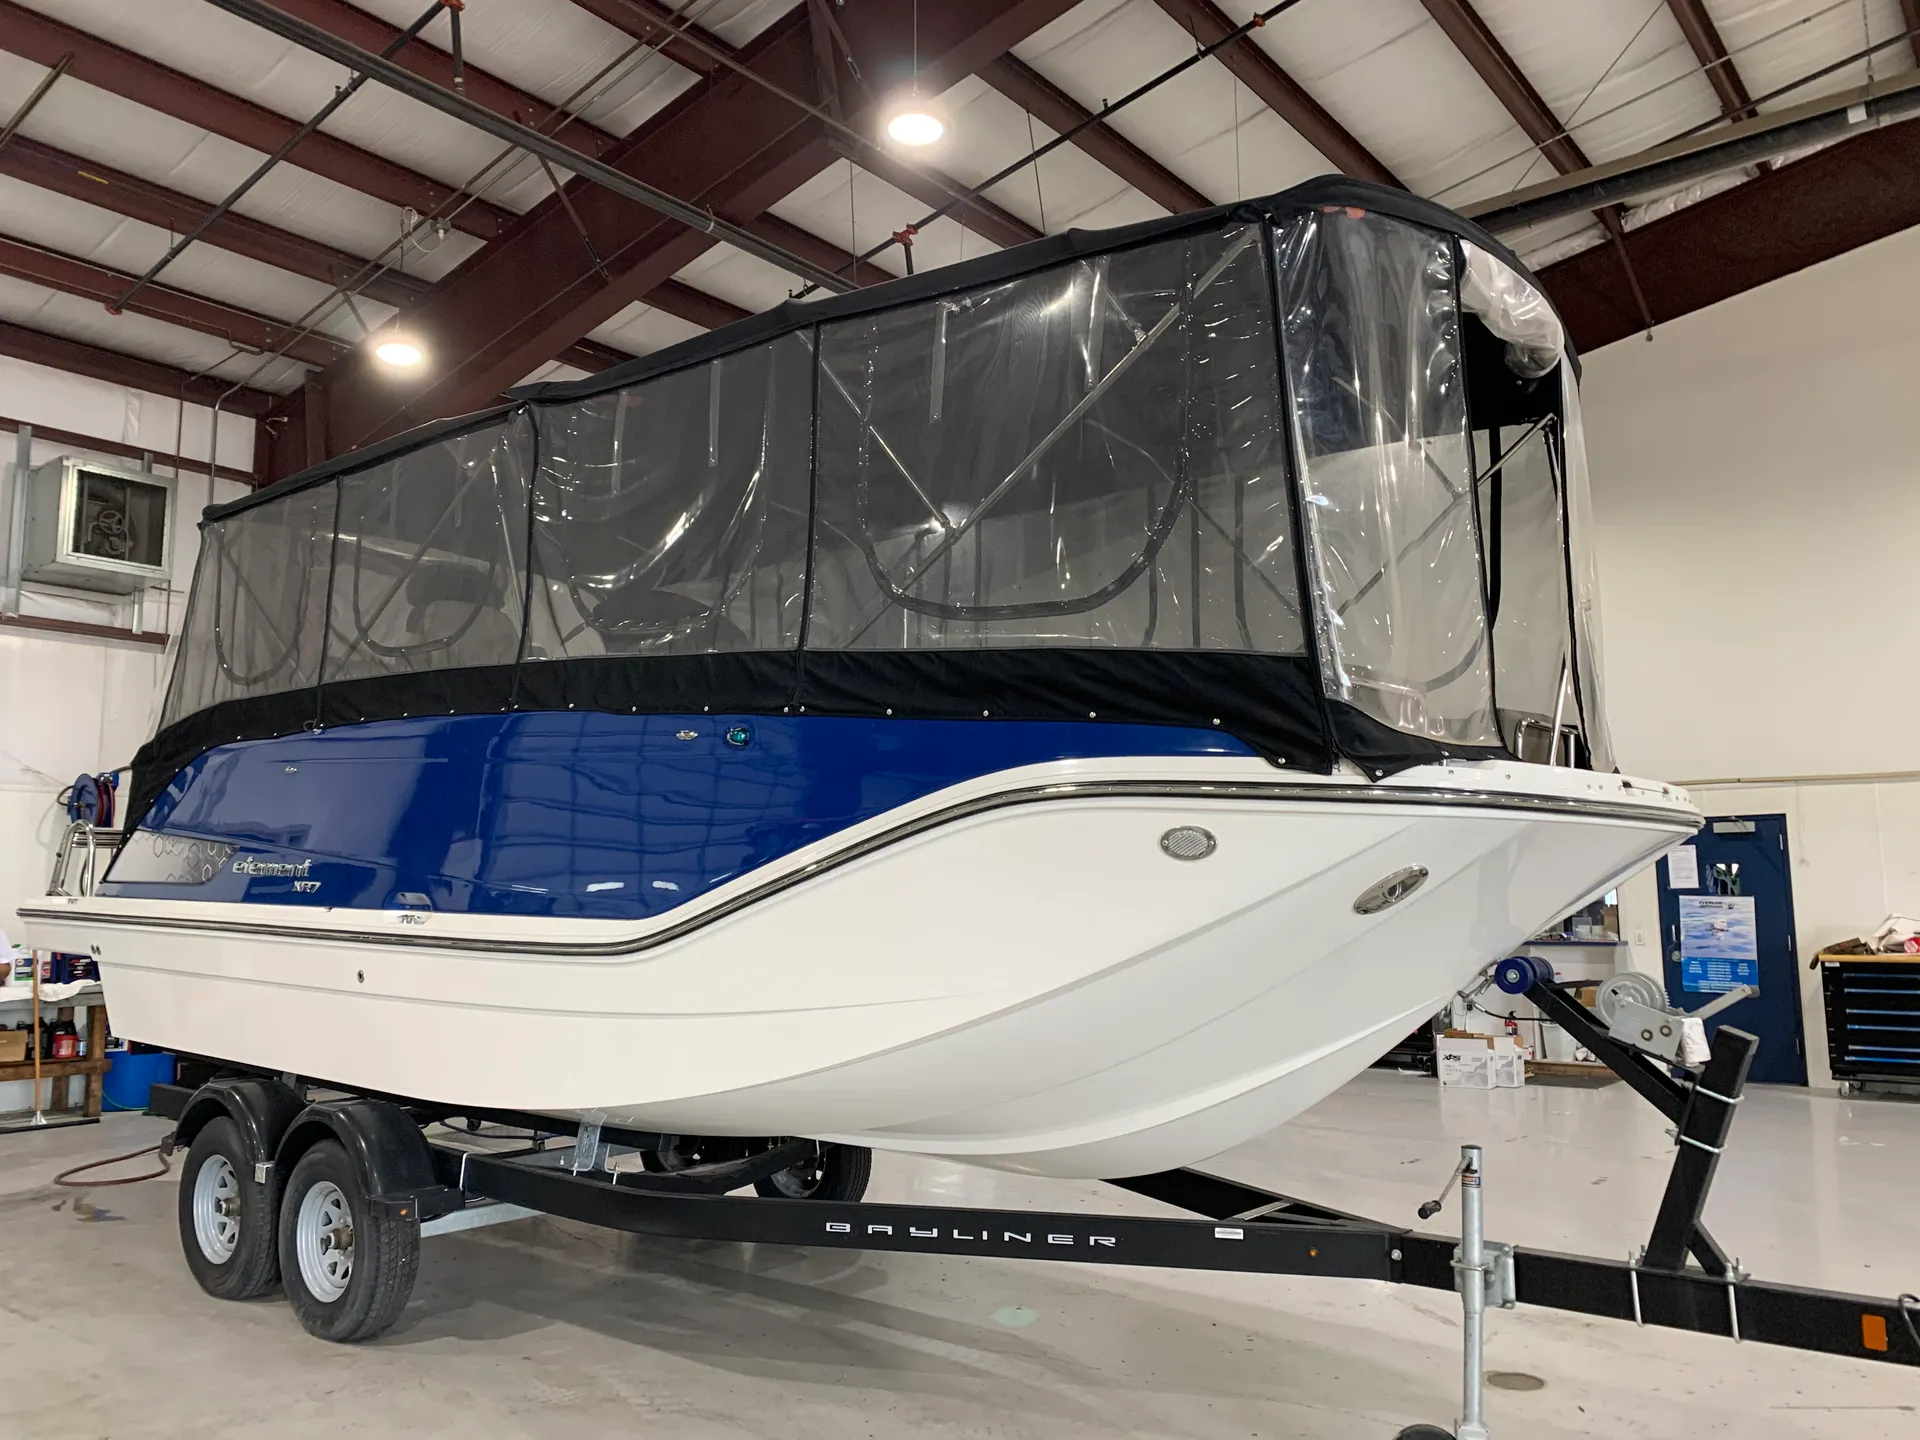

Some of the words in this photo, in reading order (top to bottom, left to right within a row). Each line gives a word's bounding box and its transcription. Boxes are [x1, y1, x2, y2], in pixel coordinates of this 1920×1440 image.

[232, 856, 312, 877] element
[291, 881, 322, 894] XR7
[1442, 1053, 1461, 1061] XPS
[826, 1222, 1116, 1247] BAYLINER
